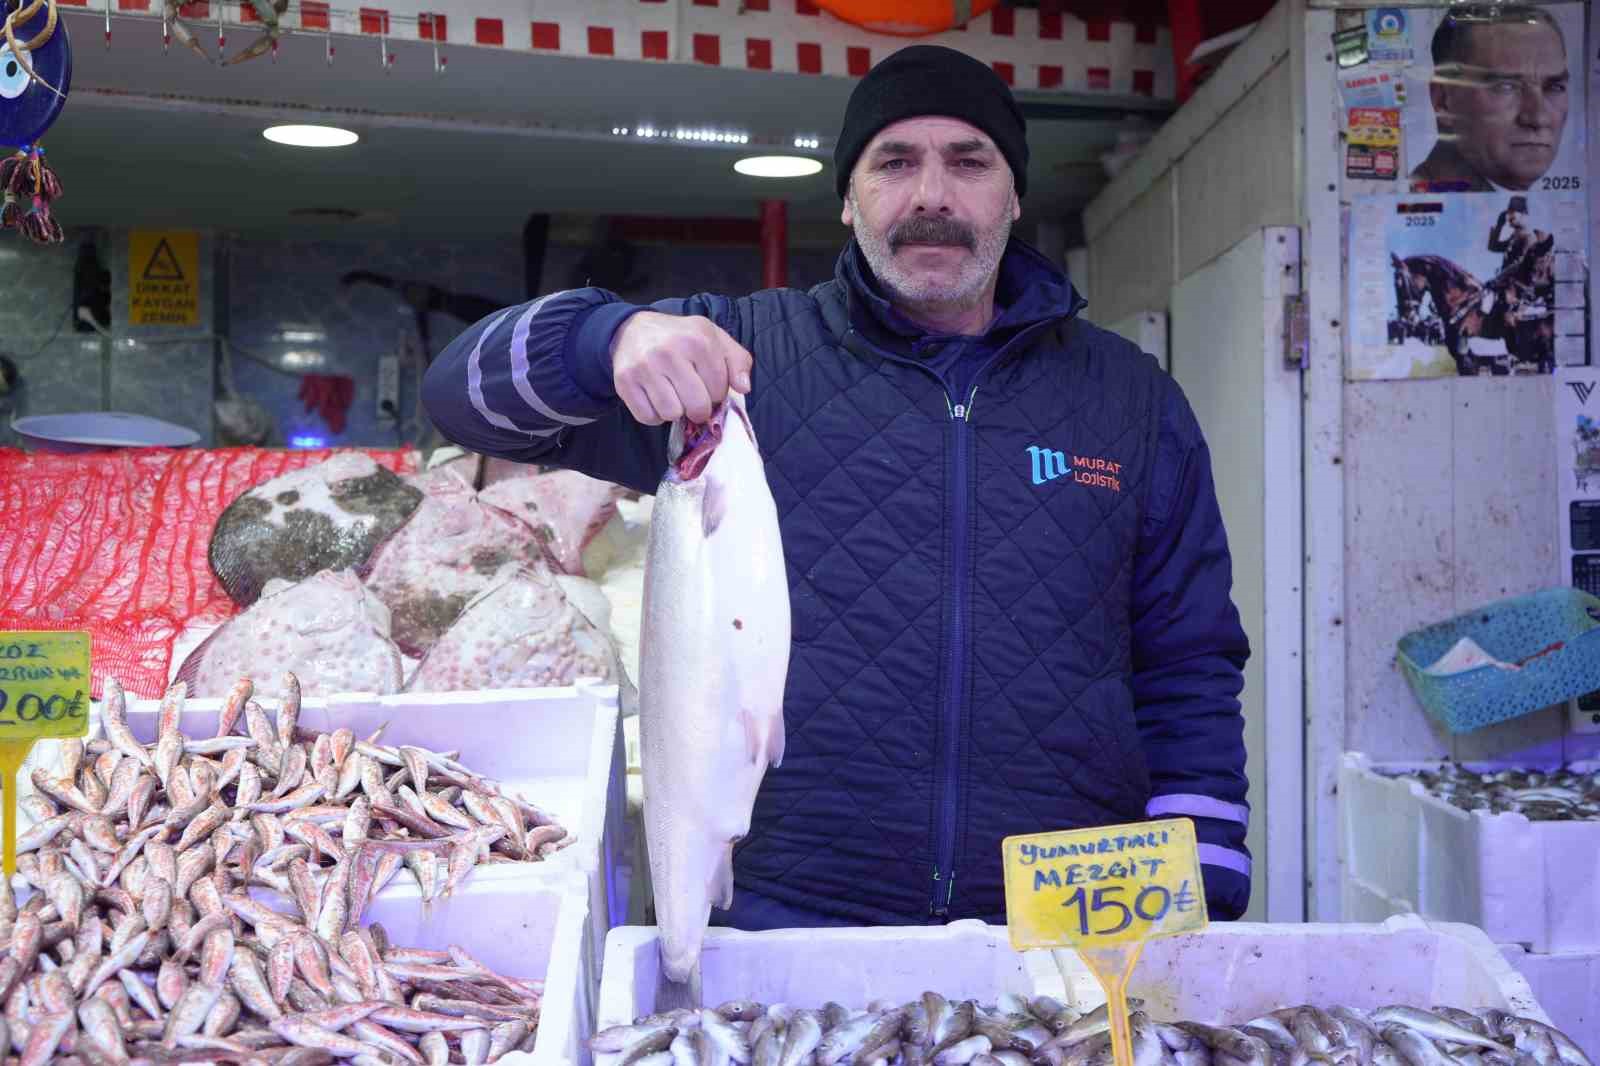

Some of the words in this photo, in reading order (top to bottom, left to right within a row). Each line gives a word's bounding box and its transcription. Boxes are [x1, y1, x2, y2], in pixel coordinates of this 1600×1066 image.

[1542, 177, 1580, 190] 2025
[1405, 216, 1436, 227] 2025
[1073, 455, 1122, 474] MURAT
